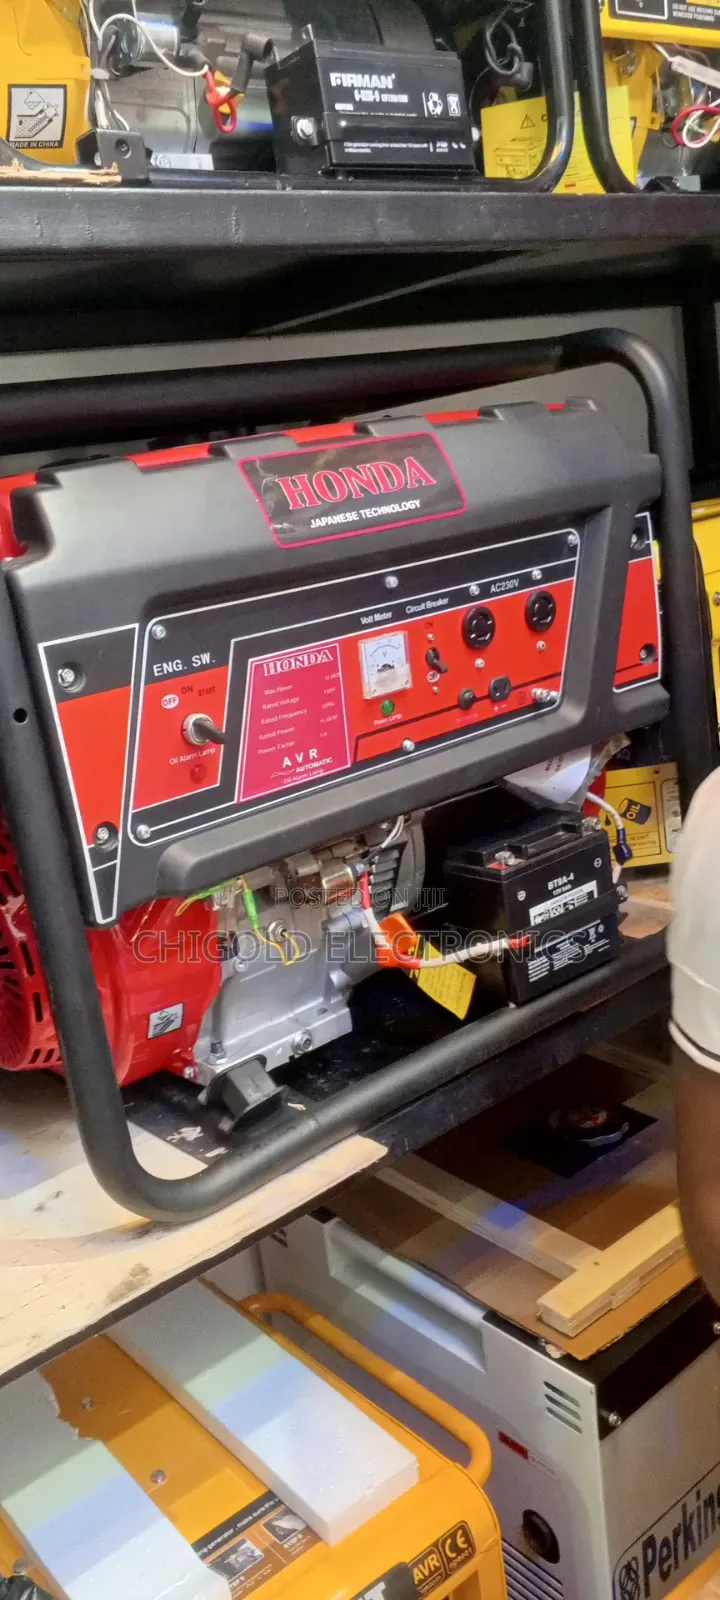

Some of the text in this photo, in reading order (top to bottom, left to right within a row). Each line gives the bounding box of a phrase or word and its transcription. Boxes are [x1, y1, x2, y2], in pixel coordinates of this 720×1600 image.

[329, 72, 394, 89] FIRMAN
[276, 456, 437, 510] HONDA
[310, 498, 421, 528] JAPANESE TECHNOLOGY
[490, 578, 520, 594] AC230V
[405, 597, 449, 614] Circuit Breaker
[360, 611, 393, 625] Volt Meter
[153, 652, 216, 677] ENG. SW.
[263, 649, 334, 677] HONDA
[181, 685, 193, 695] ON
[198, 685, 217, 697] START
[162, 696, 178, 707] OFF
[262, 701, 279, 710] Rated
[261, 714, 278, 724] Rated
[277, 727, 296, 736] Power
[179, 751, 198, 763] Alarm
[295, 756, 333, 774] AUTOMATIC
[626, 803, 641, 820] OIL
[547, 871, 575, 891] BT9A-4
[413, 1553, 441, 1585] AVR
